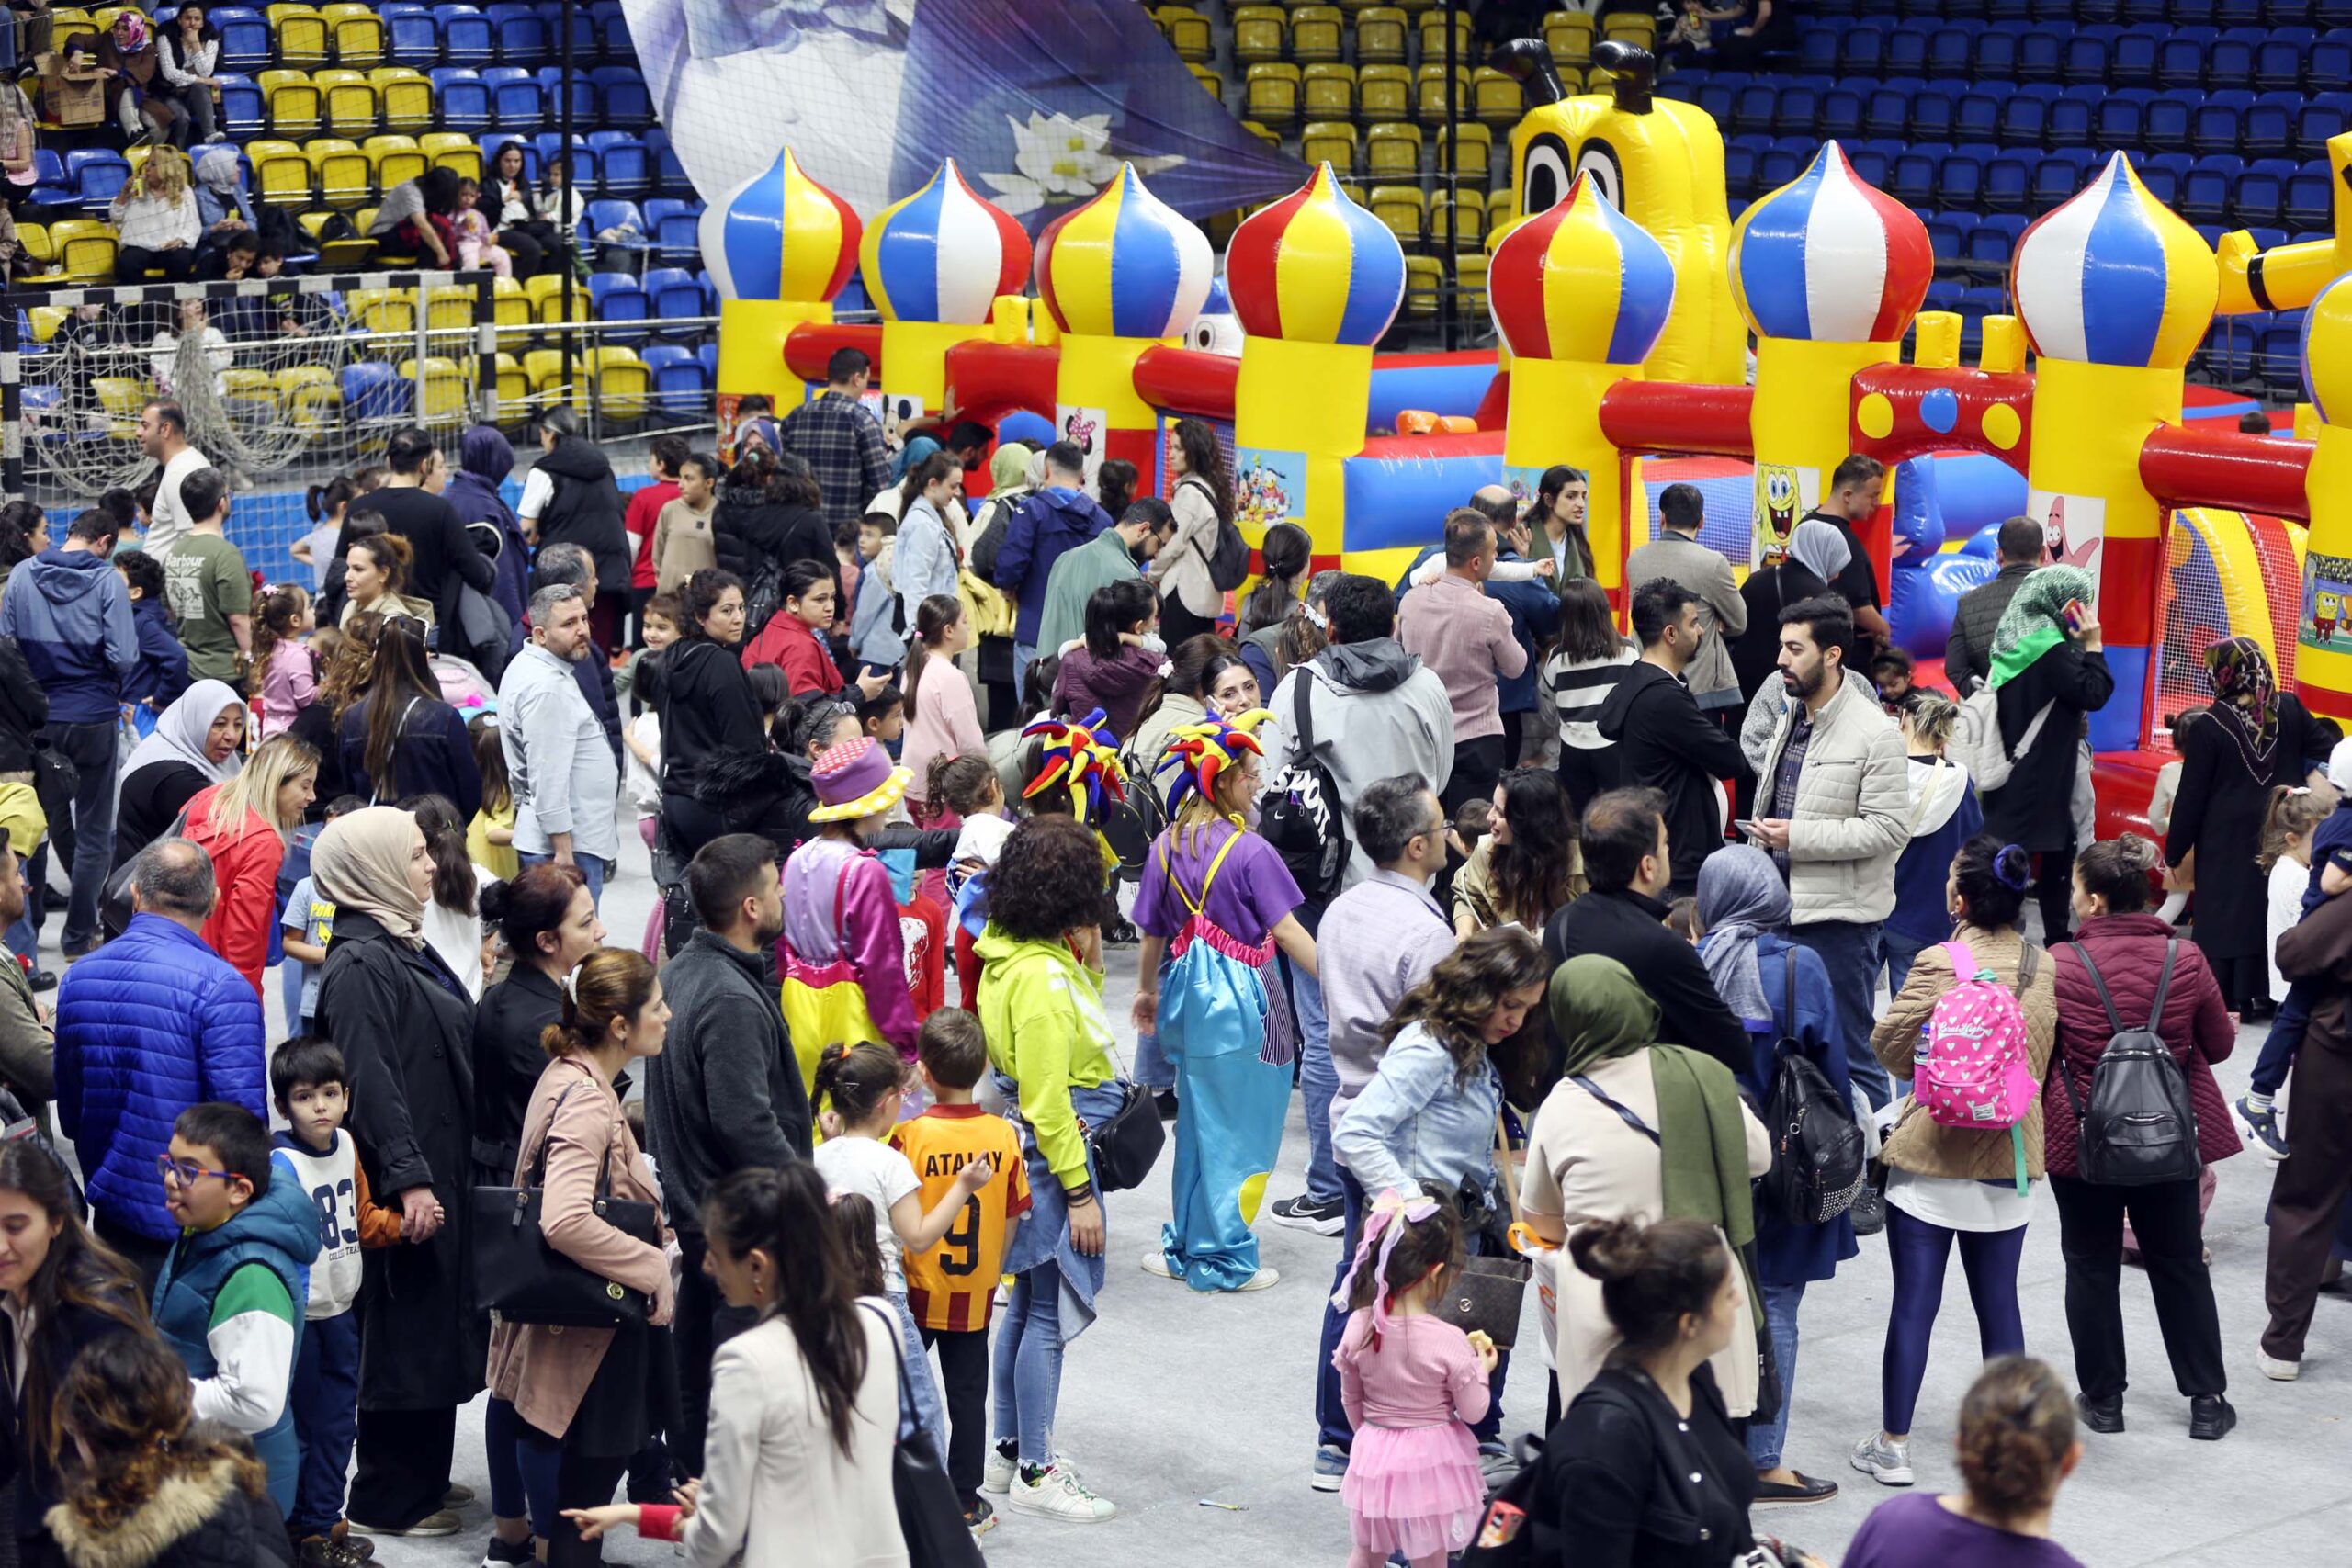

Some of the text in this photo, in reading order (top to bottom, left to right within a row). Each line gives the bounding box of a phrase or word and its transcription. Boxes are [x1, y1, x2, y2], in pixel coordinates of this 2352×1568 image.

[166, 553, 206, 567] Barbour
[312, 1178, 359, 1250] 83
[940, 1192, 980, 1276] 9
